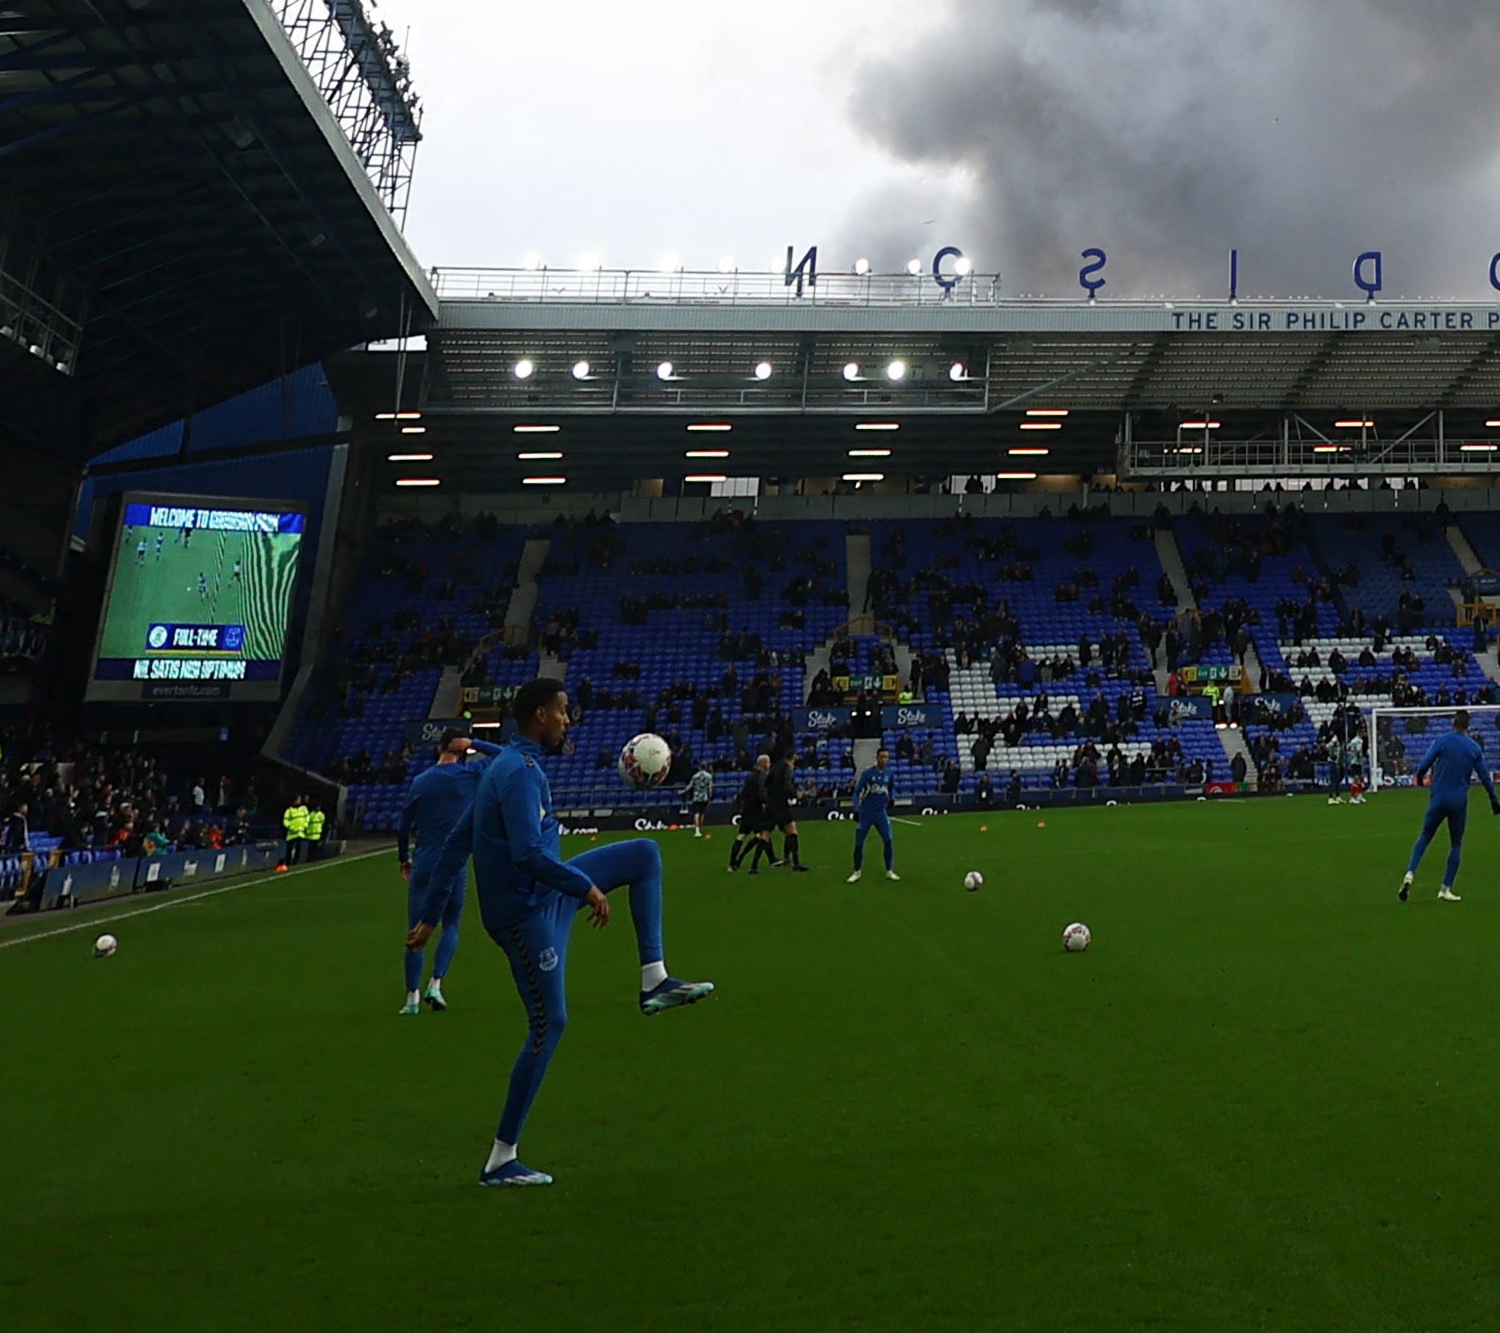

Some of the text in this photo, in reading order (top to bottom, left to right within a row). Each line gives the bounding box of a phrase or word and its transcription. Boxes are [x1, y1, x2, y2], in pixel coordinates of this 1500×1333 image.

[1172, 312, 1217, 331] THE
[1232, 312, 1271, 331] SIR
[1286, 312, 1367, 331] PHILIP
[1380, 312, 1474, 331] CARTER
[149, 506, 195, 529] WELCOME
[196, 508, 208, 530] TO
